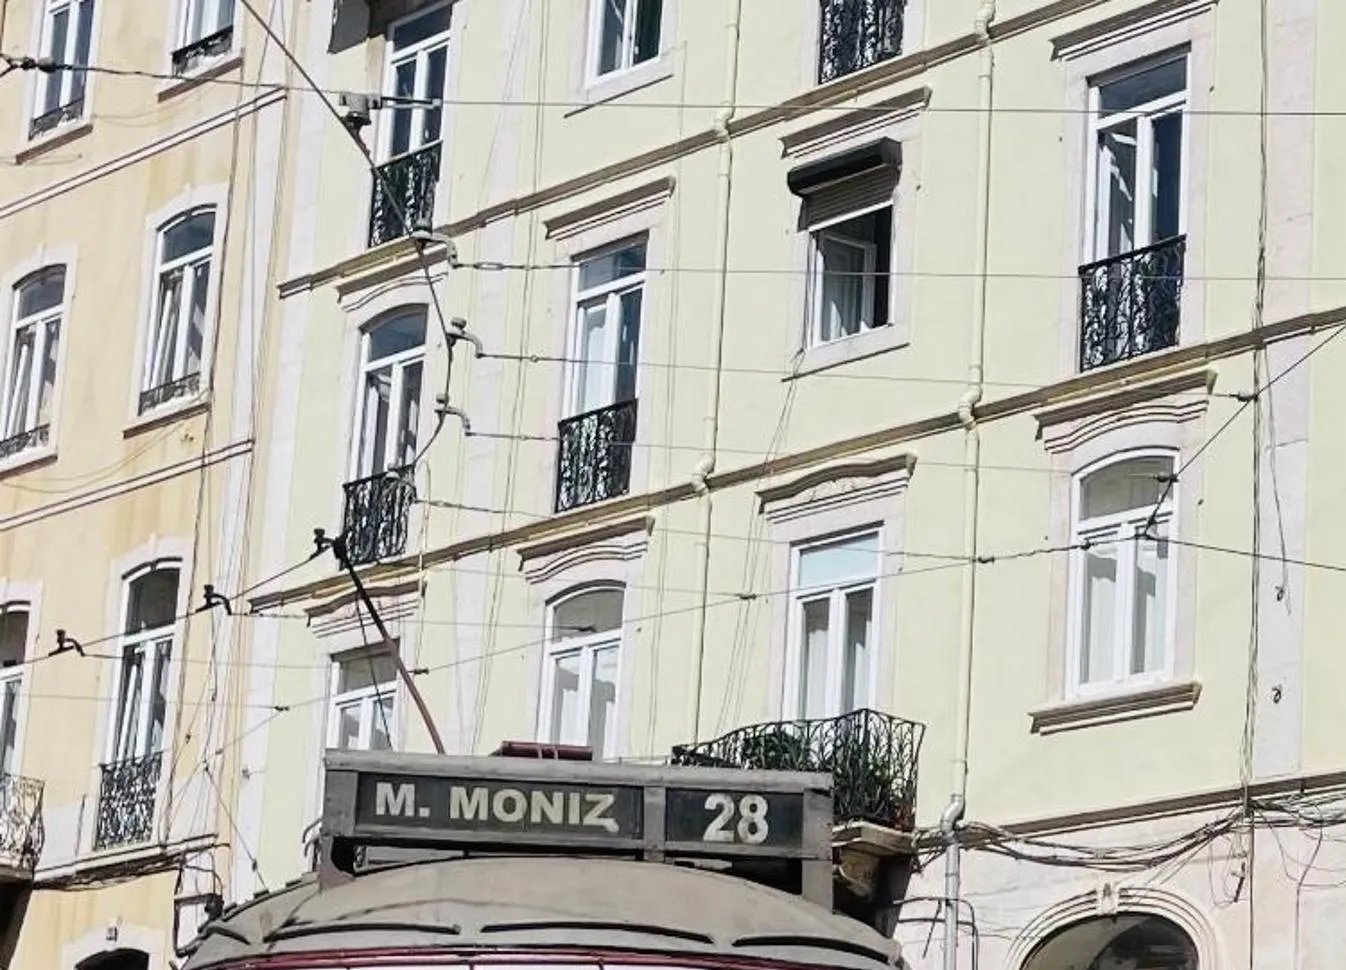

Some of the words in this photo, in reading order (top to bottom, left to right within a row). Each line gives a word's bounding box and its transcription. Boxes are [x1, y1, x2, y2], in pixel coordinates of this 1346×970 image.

[376, 781, 431, 818] M.
[450, 786, 619, 833] MONIZ
[703, 792, 769, 844] 28
